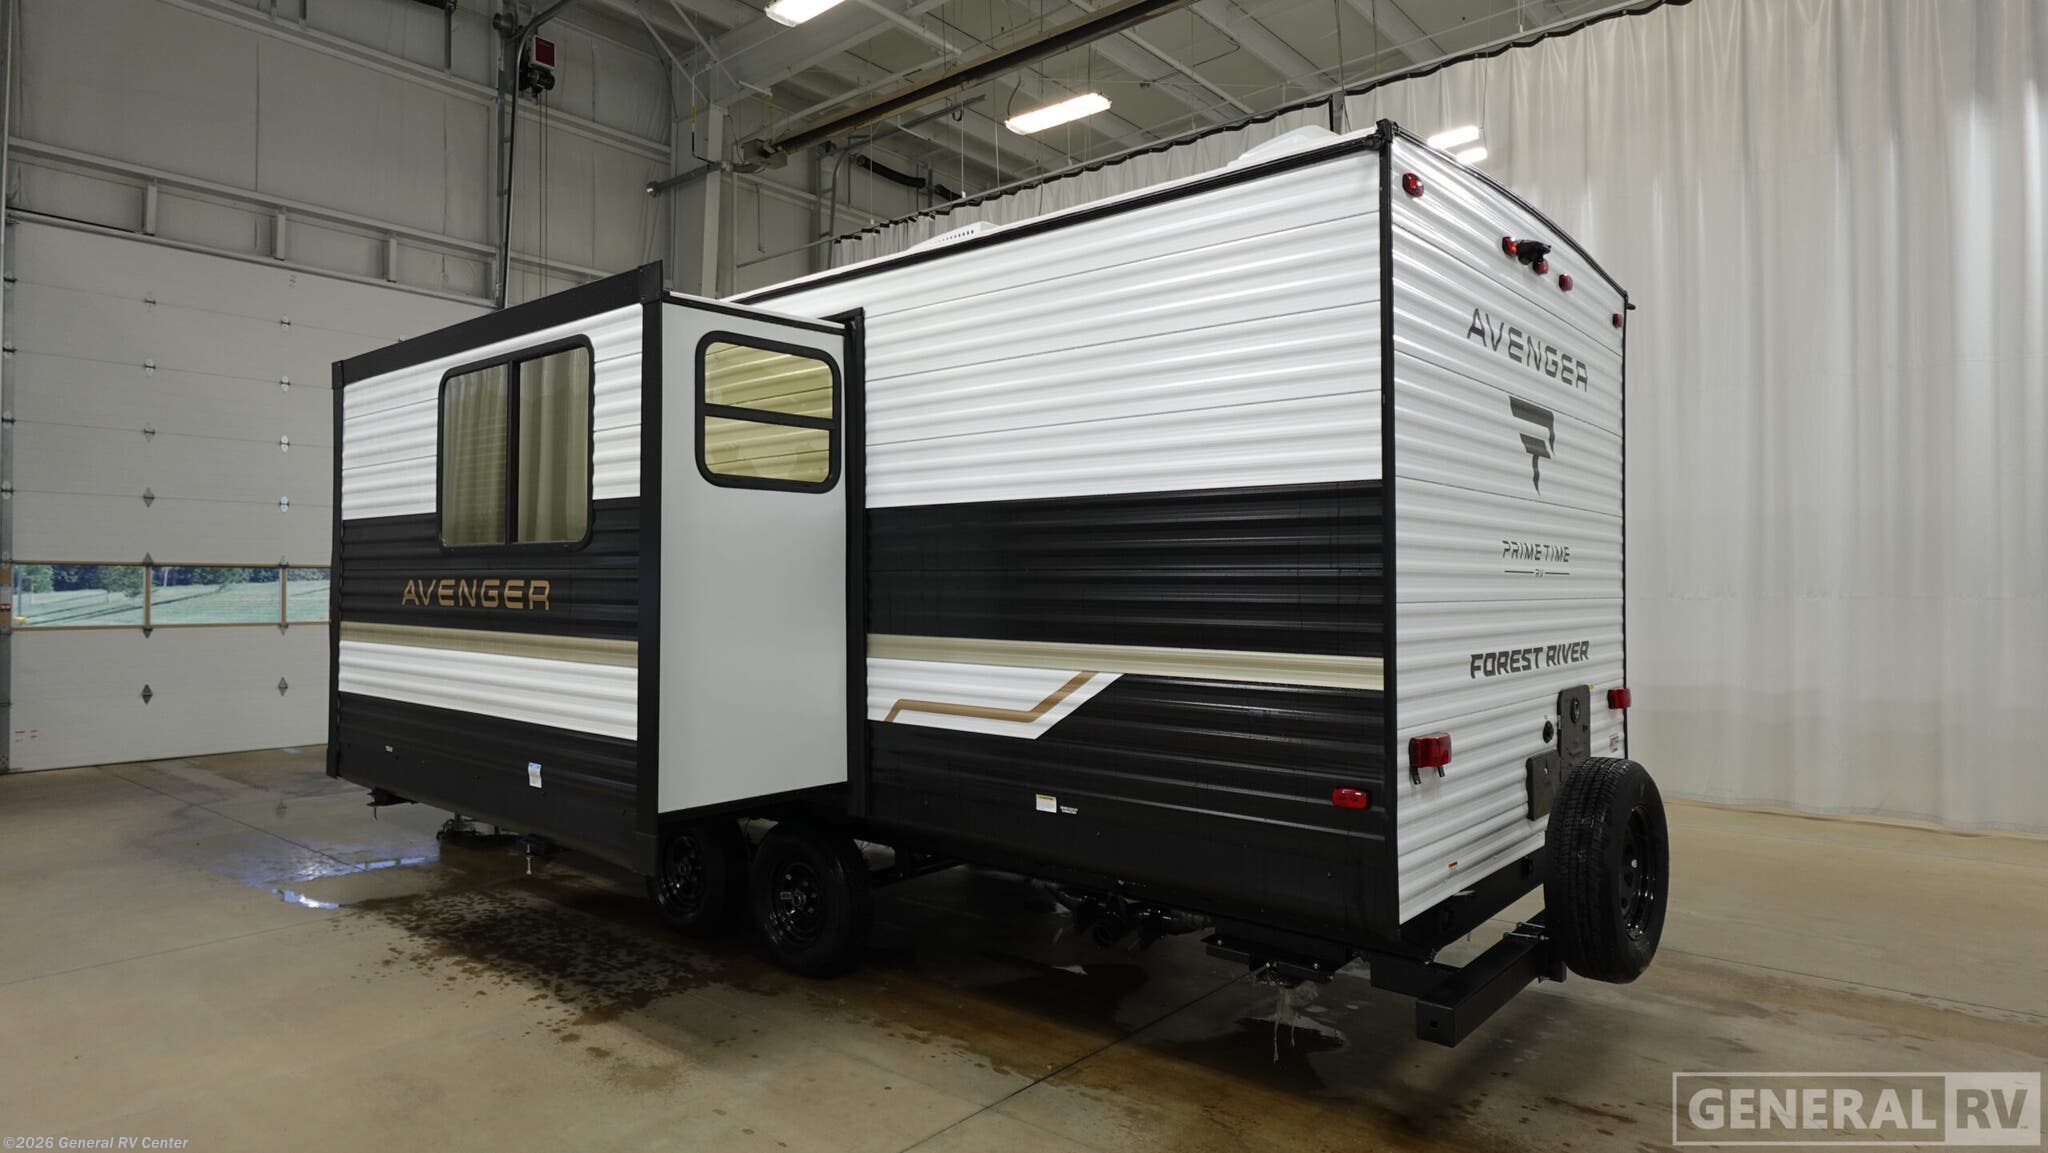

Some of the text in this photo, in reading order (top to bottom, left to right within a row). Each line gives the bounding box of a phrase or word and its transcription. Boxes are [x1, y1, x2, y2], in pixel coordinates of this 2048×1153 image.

[1466, 307, 1589, 393] AVENGER
[401, 578, 551, 611] AVENGER
[1470, 640, 1590, 679] FOREST RIVER
